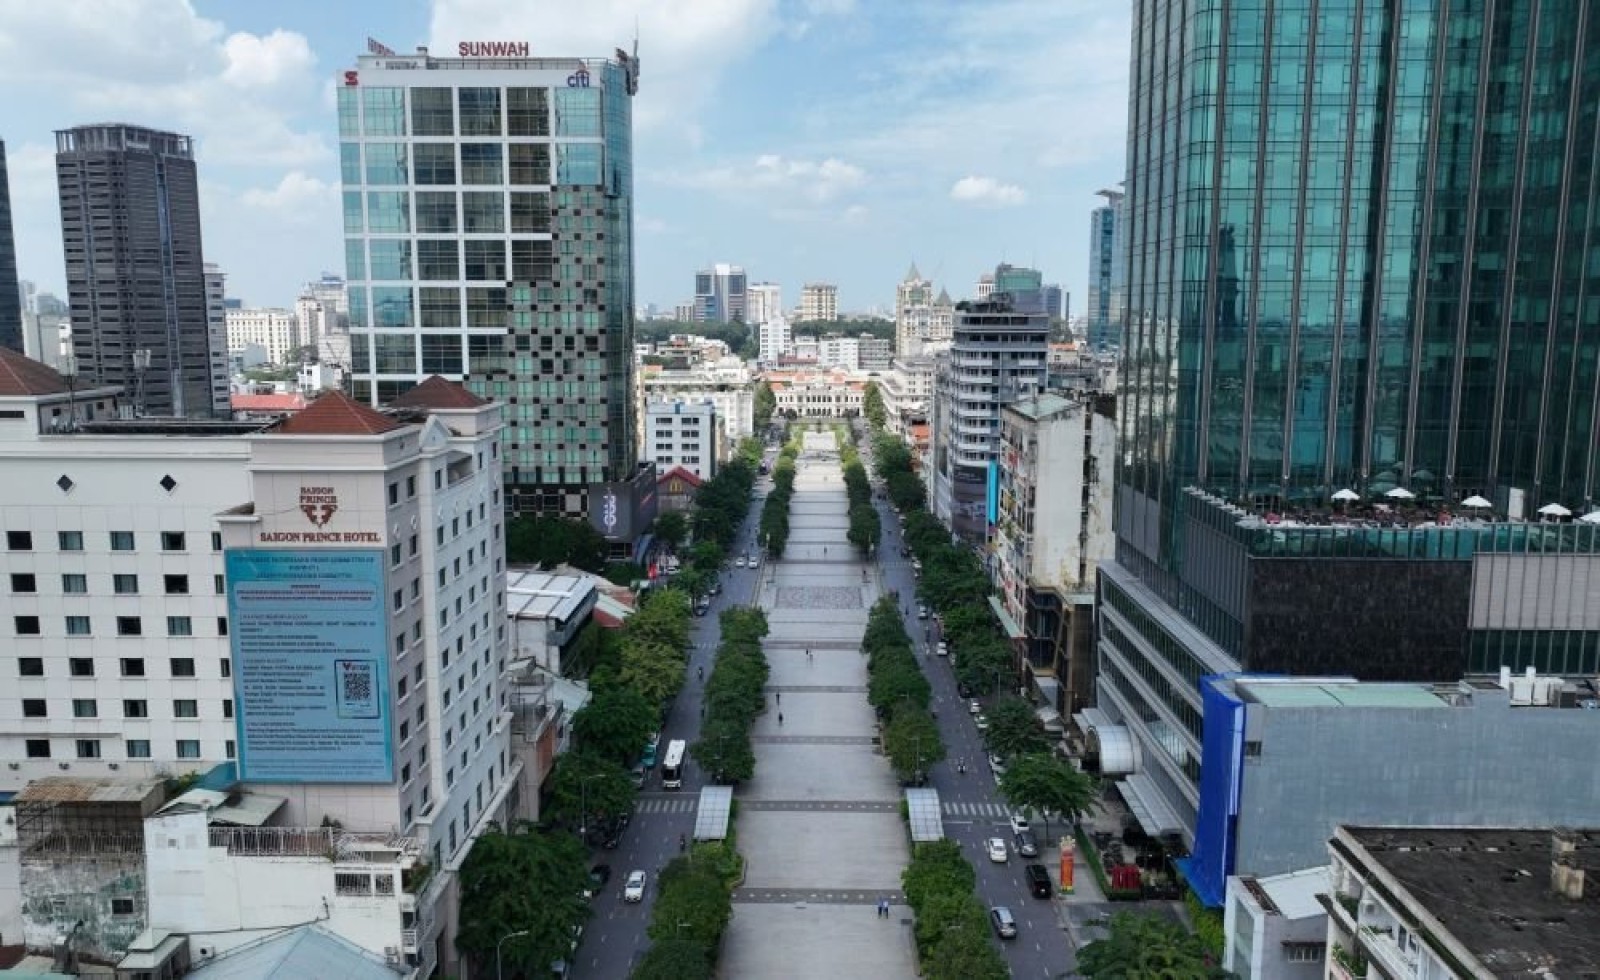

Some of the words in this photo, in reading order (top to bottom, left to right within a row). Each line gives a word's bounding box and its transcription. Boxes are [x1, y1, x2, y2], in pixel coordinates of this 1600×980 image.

[459, 41, 528, 56] SUNWAH
[568, 70, 589, 87] citi
[300, 487, 334, 495] SAIGON
[300, 495, 337, 504] PRINCE
[260, 532, 299, 542] SAIGON
[302, 532, 341, 543] PRINCE
[344, 532, 381, 543] HOTEL
